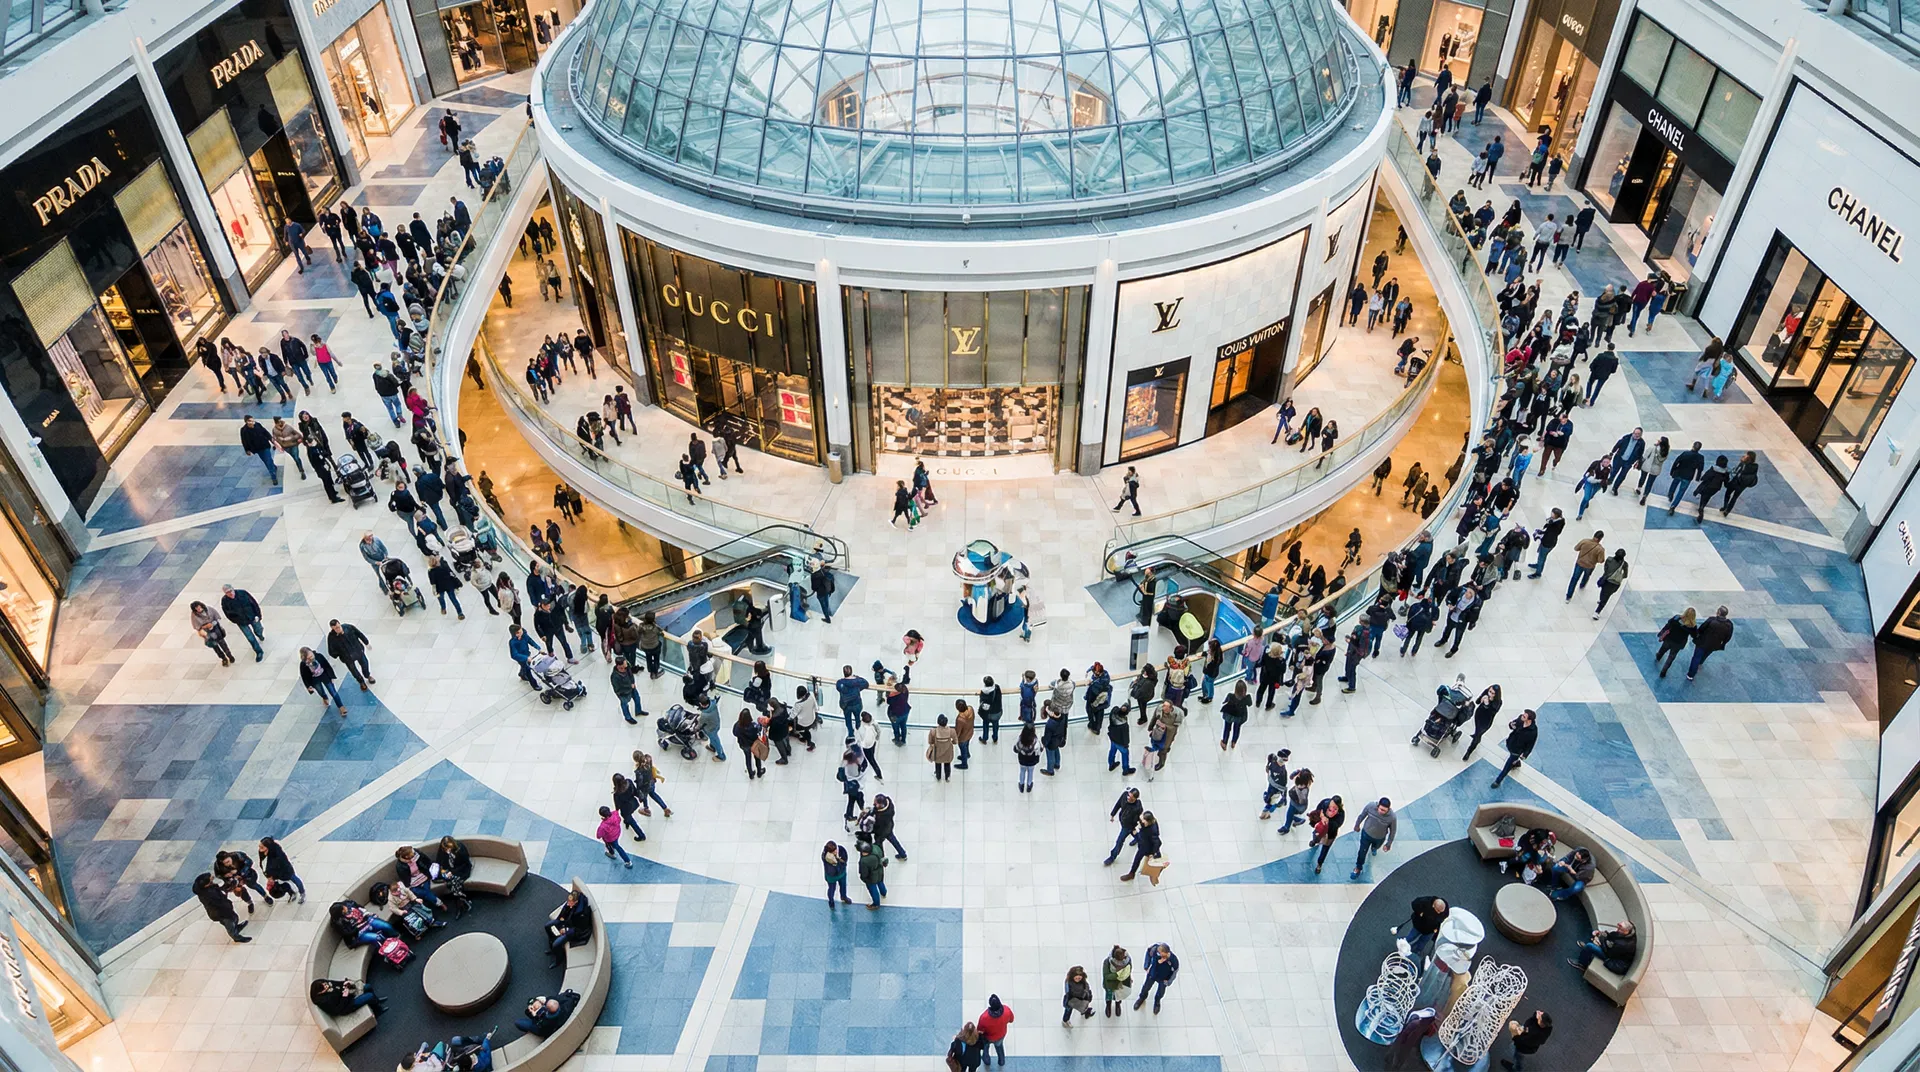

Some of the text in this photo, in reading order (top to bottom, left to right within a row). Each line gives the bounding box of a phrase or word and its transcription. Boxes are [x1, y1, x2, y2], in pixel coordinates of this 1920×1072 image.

[210, 39, 265, 89] PRADA
[1647, 108, 1685, 152] CHANEL
[32, 156, 112, 226] PRADA
[1827, 186, 1902, 263] CHANEL
[662, 283, 774, 338] GUCCI
[1151, 296, 1184, 333] LV
[951, 326, 982, 355] LV
[1220, 320, 1285, 358] LOUIS VUITTON
